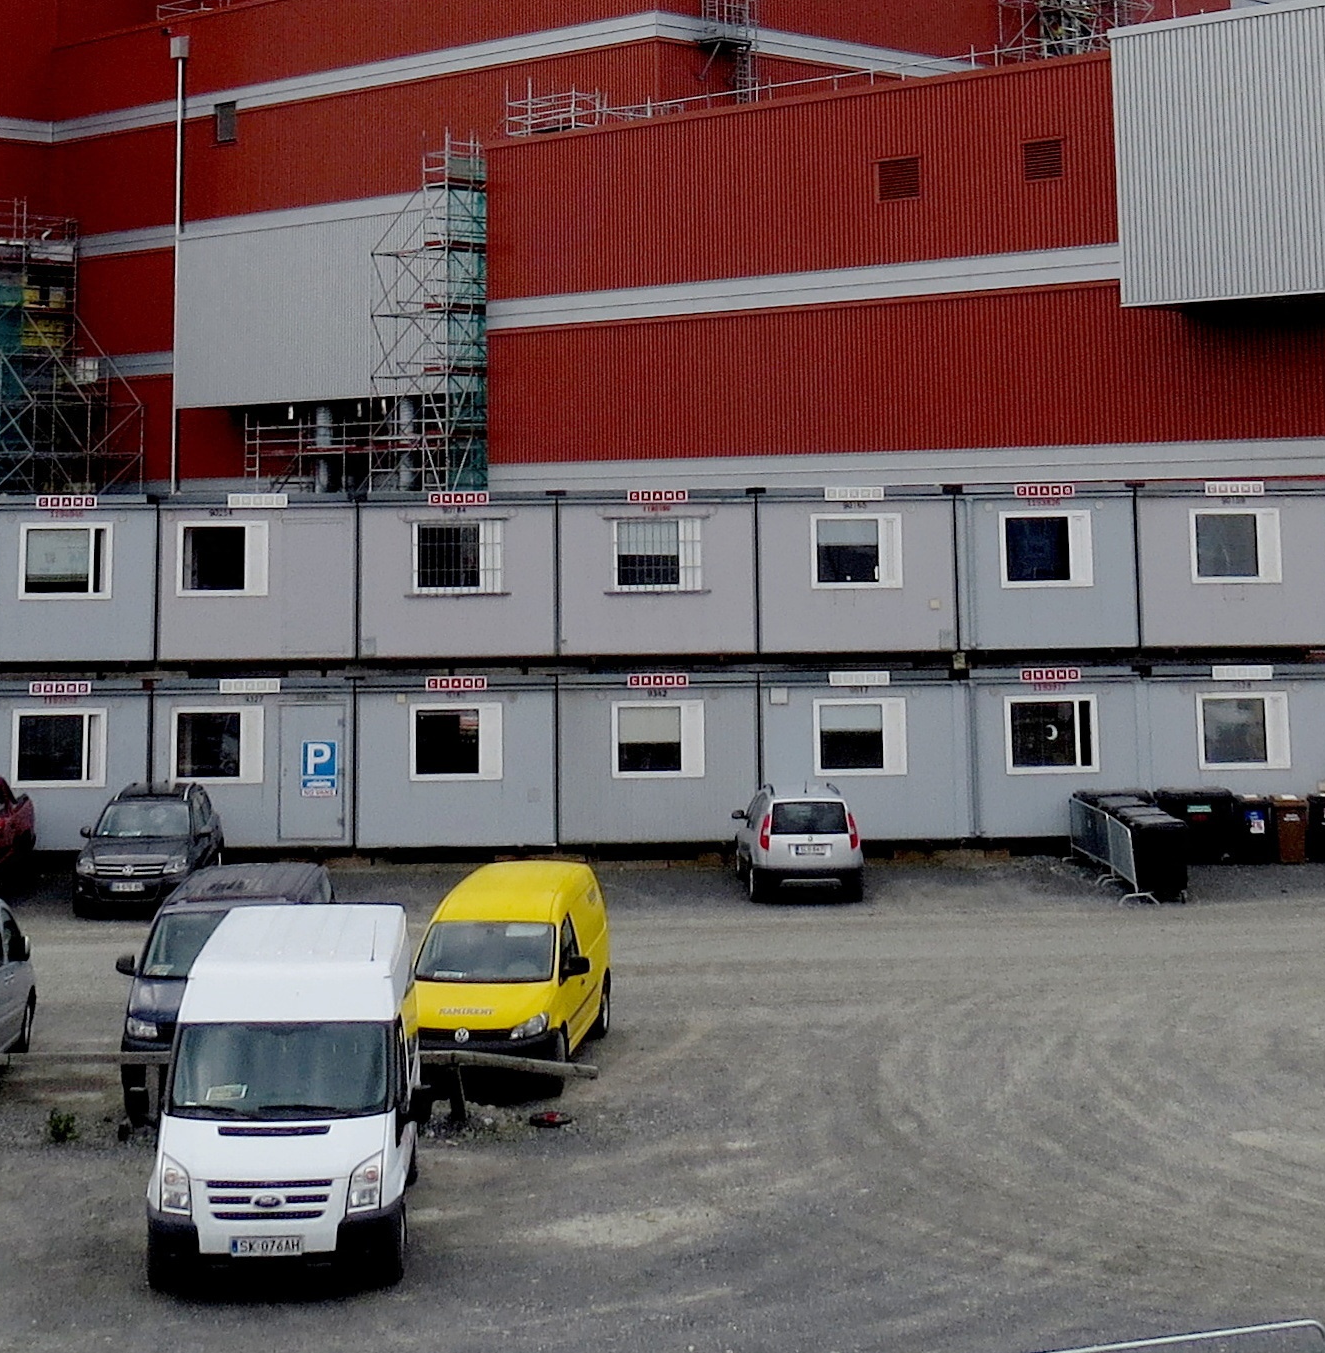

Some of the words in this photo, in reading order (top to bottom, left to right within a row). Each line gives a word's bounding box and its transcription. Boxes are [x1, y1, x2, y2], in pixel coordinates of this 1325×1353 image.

[630, 490, 686, 501] CRAMO
[1017, 485, 1073, 496] CRAMO
[39, 497, 95, 507] CRAMO
[431, 493, 487, 503] CRAMO
[1022, 669, 1078, 680] CRAMO
[428, 678, 485, 689] CRAMO
[630, 675, 686, 686] CRAMO
[32, 682, 89, 693] CRAMO
[307, 743, 331, 775] P
[239, 1240, 257, 1253] SK
